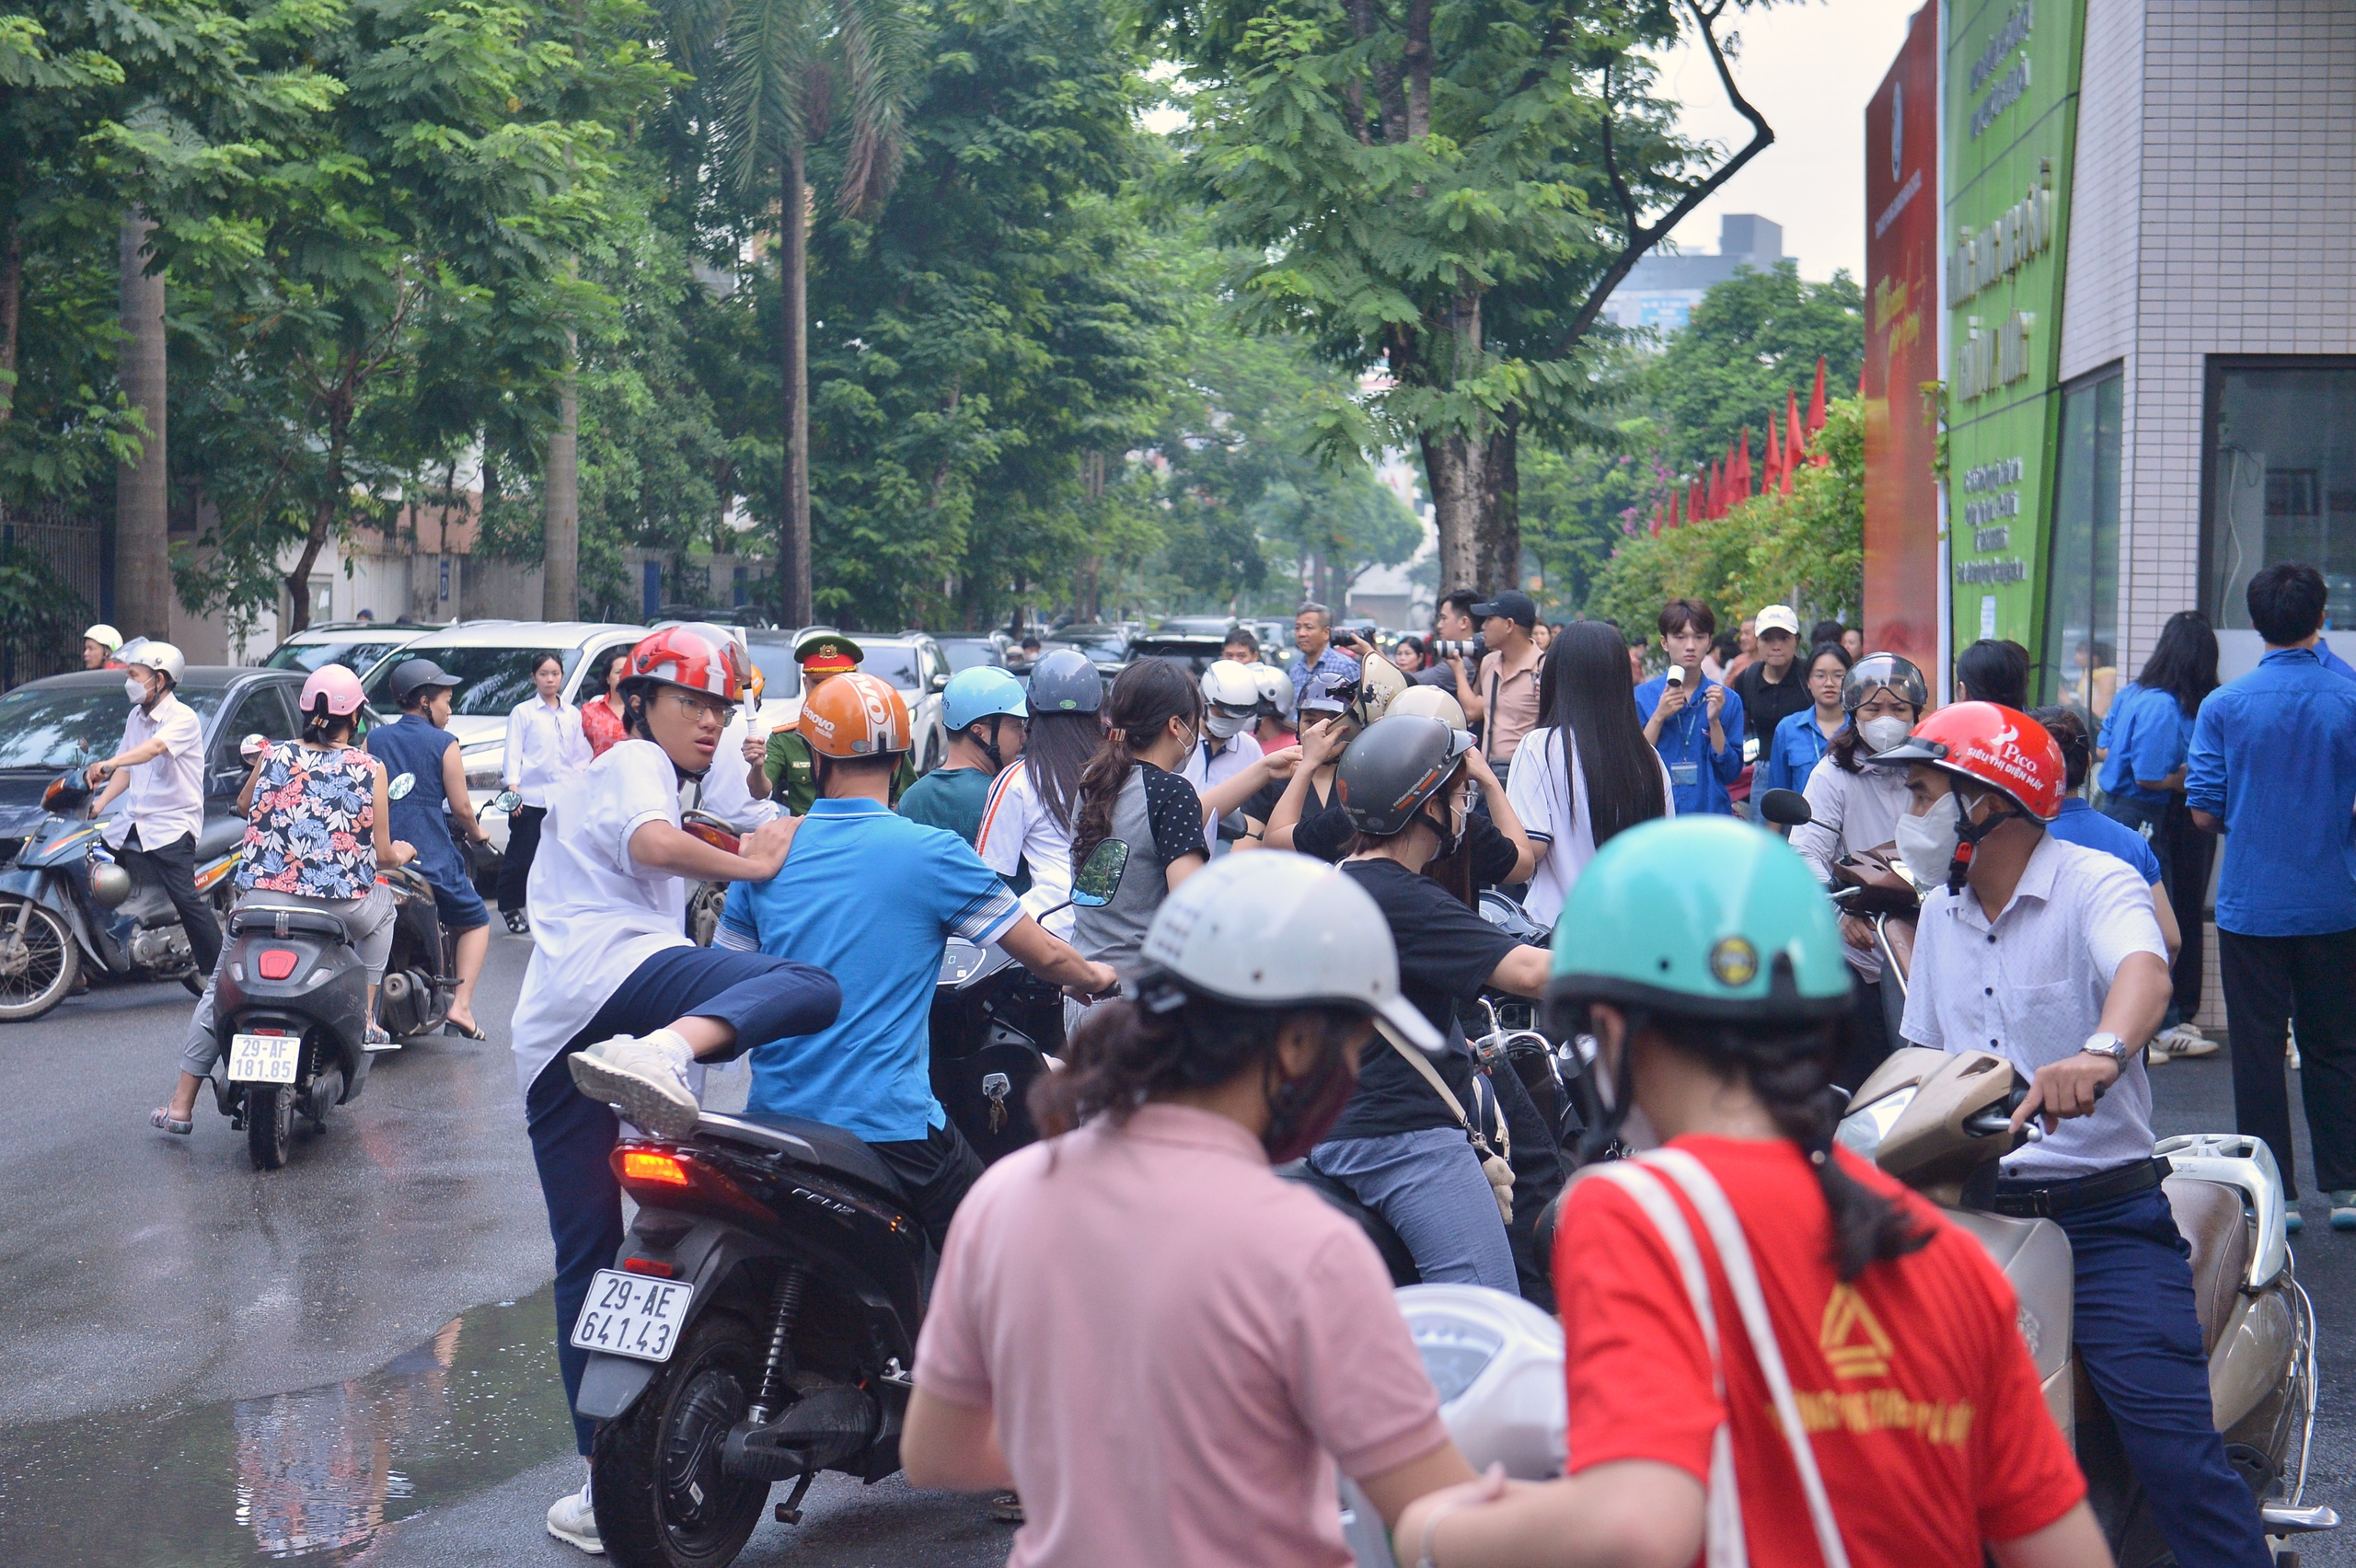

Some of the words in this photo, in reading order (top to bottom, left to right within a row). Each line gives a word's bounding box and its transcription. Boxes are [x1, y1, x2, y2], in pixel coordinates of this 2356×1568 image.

[1967, 747, 1990, 762] SIÊU
[1989, 755, 2005, 771] THỊ
[2004, 763, 2027, 780] ĐIỆN
[2026, 775, 2044, 791] MÁY
[236, 1058, 292, 1078] 181.85
[241, 1039, 289, 1059] 29-AF
[600, 1278, 676, 1318] 29-AE
[581, 1312, 671, 1355] 641.43
